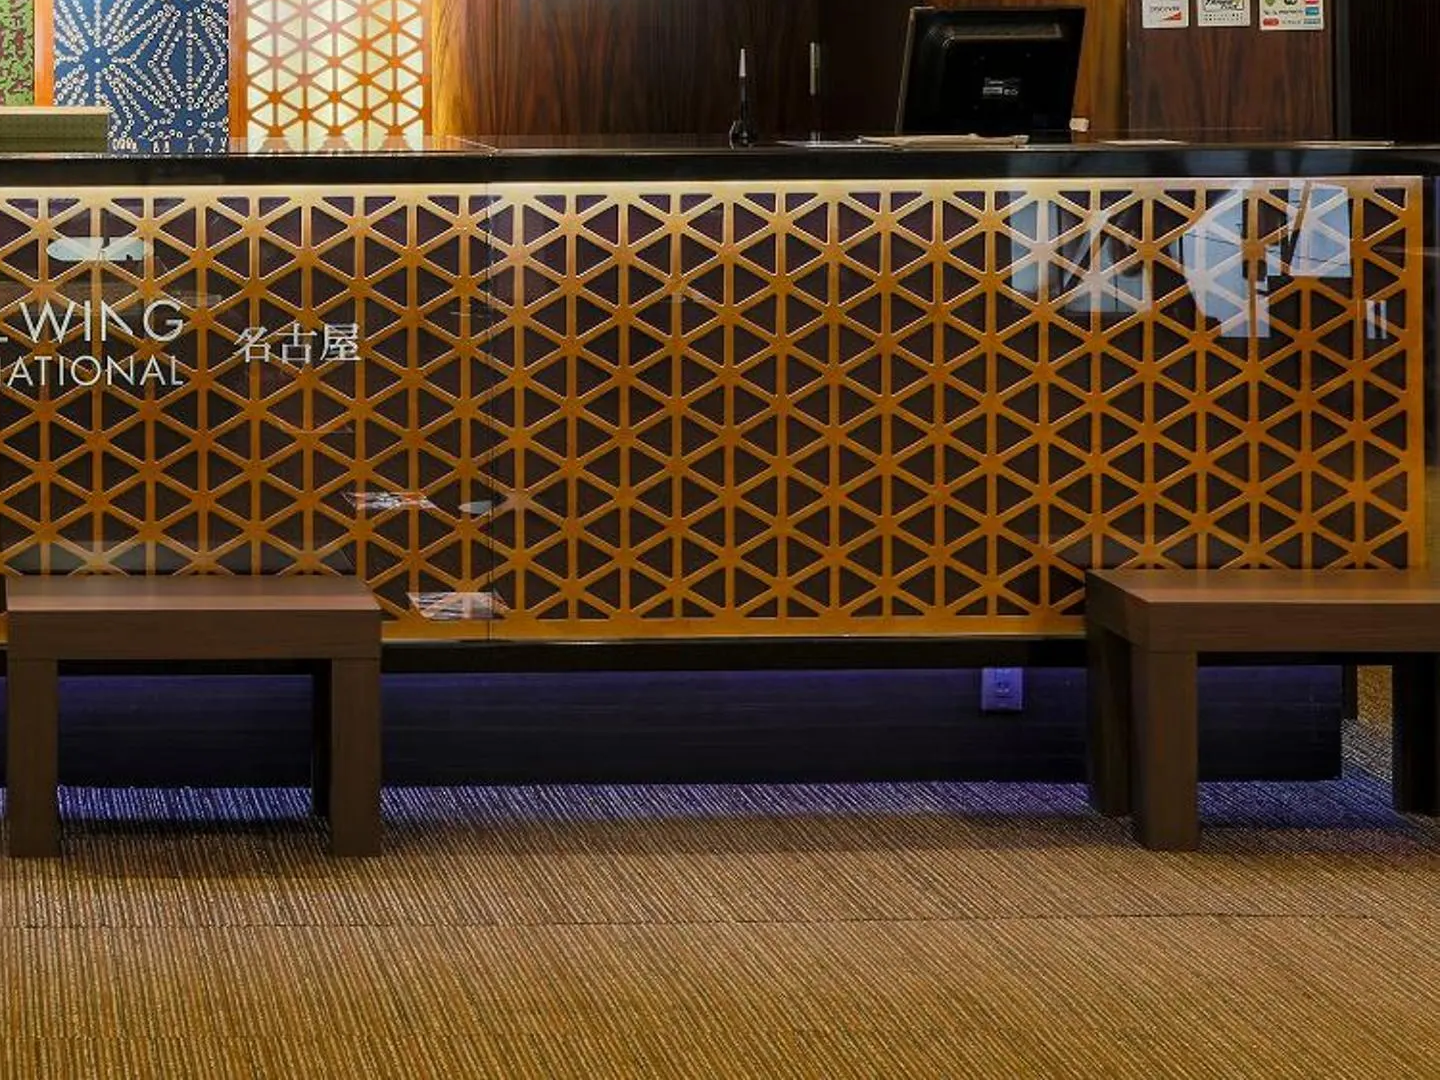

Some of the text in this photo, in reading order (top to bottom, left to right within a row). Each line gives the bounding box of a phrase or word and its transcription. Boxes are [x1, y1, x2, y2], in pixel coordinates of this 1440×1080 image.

[19, 301, 185, 344] WING
[234, 322, 362, 365] 名古屋
